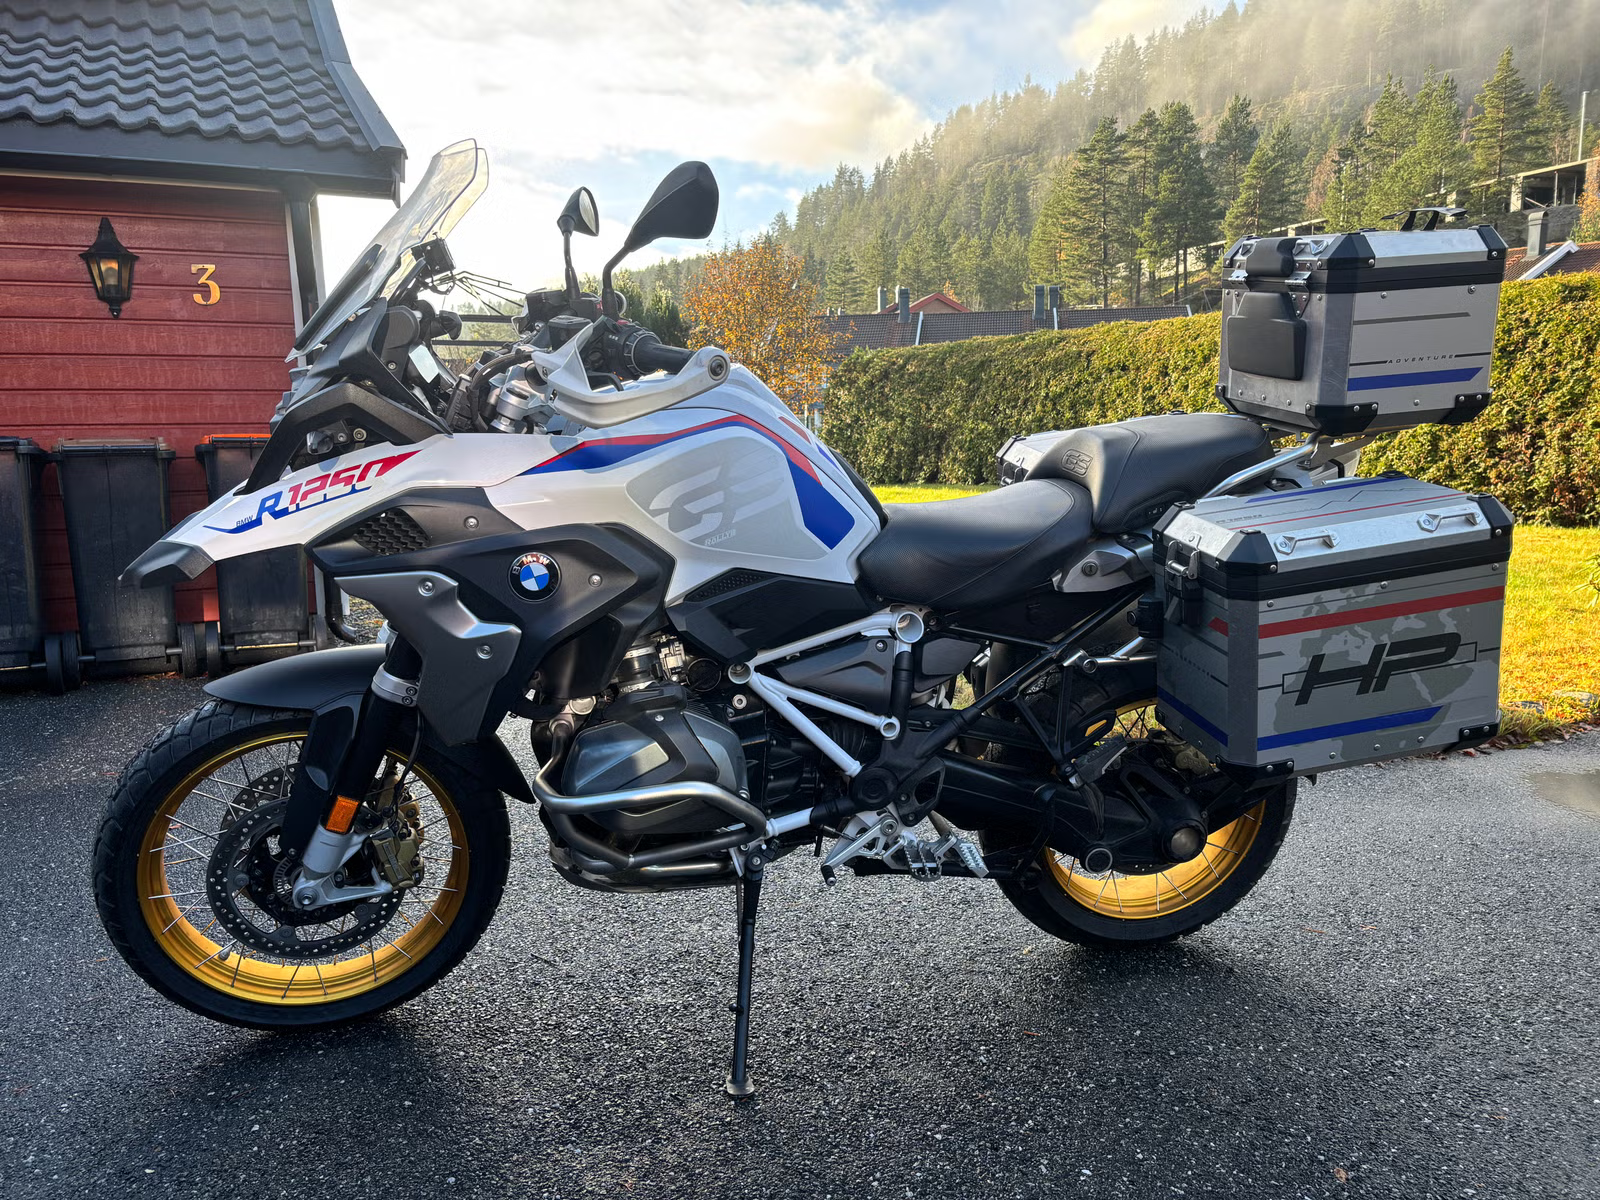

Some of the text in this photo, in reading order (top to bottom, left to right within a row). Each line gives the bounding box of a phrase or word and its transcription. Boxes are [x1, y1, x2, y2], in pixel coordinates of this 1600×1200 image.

[191, 264, 221, 305] 3
[1388, 354, 1453, 364] ADVENTURE
[235, 514, 254, 527] BMW
[511, 554, 550, 575] BMW
[1295, 632, 1462, 707] HP
